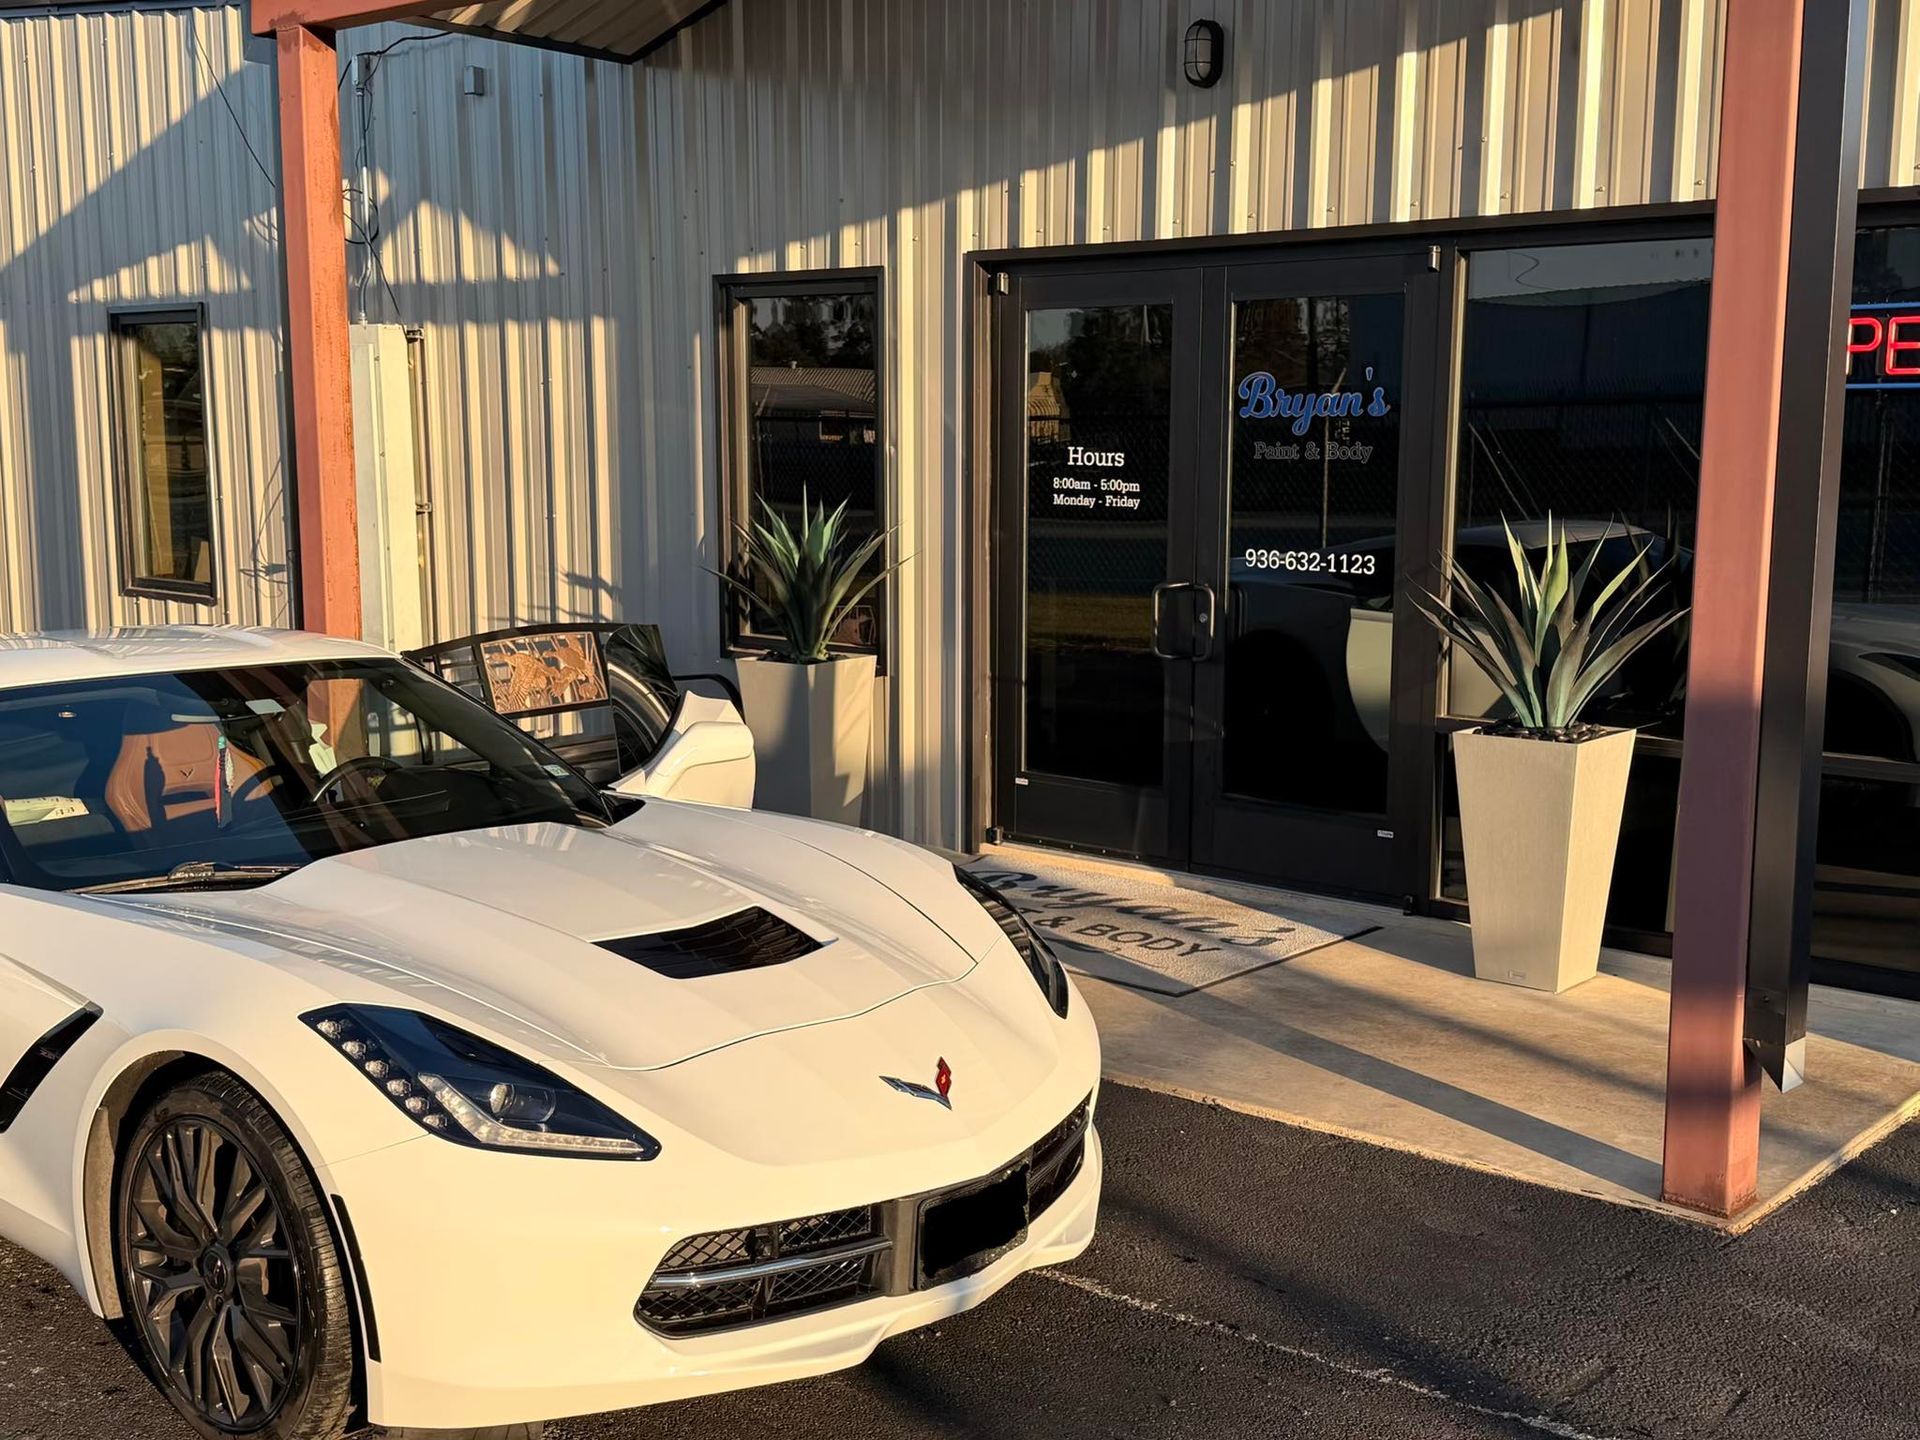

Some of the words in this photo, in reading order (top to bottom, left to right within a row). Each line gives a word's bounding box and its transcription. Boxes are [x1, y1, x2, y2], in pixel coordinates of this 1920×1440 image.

[1238, 367, 1390, 436] Bryan's
[1067, 446, 1125, 467] Hours
[1254, 441, 1299, 460] Paint
[1305, 442, 1320, 460] &
[1327, 442, 1373, 464] Body
[1053, 477, 1091, 490] 8:00am
[1100, 479, 1140, 493] 5:00pm
[1053, 493, 1096, 508] Monday
[1105, 495, 1140, 509] Friday
[1245, 549, 1375, 575] 936-632-1123
[1034, 915, 1075, 929] &
[1076, 923, 1221, 957] BODY
